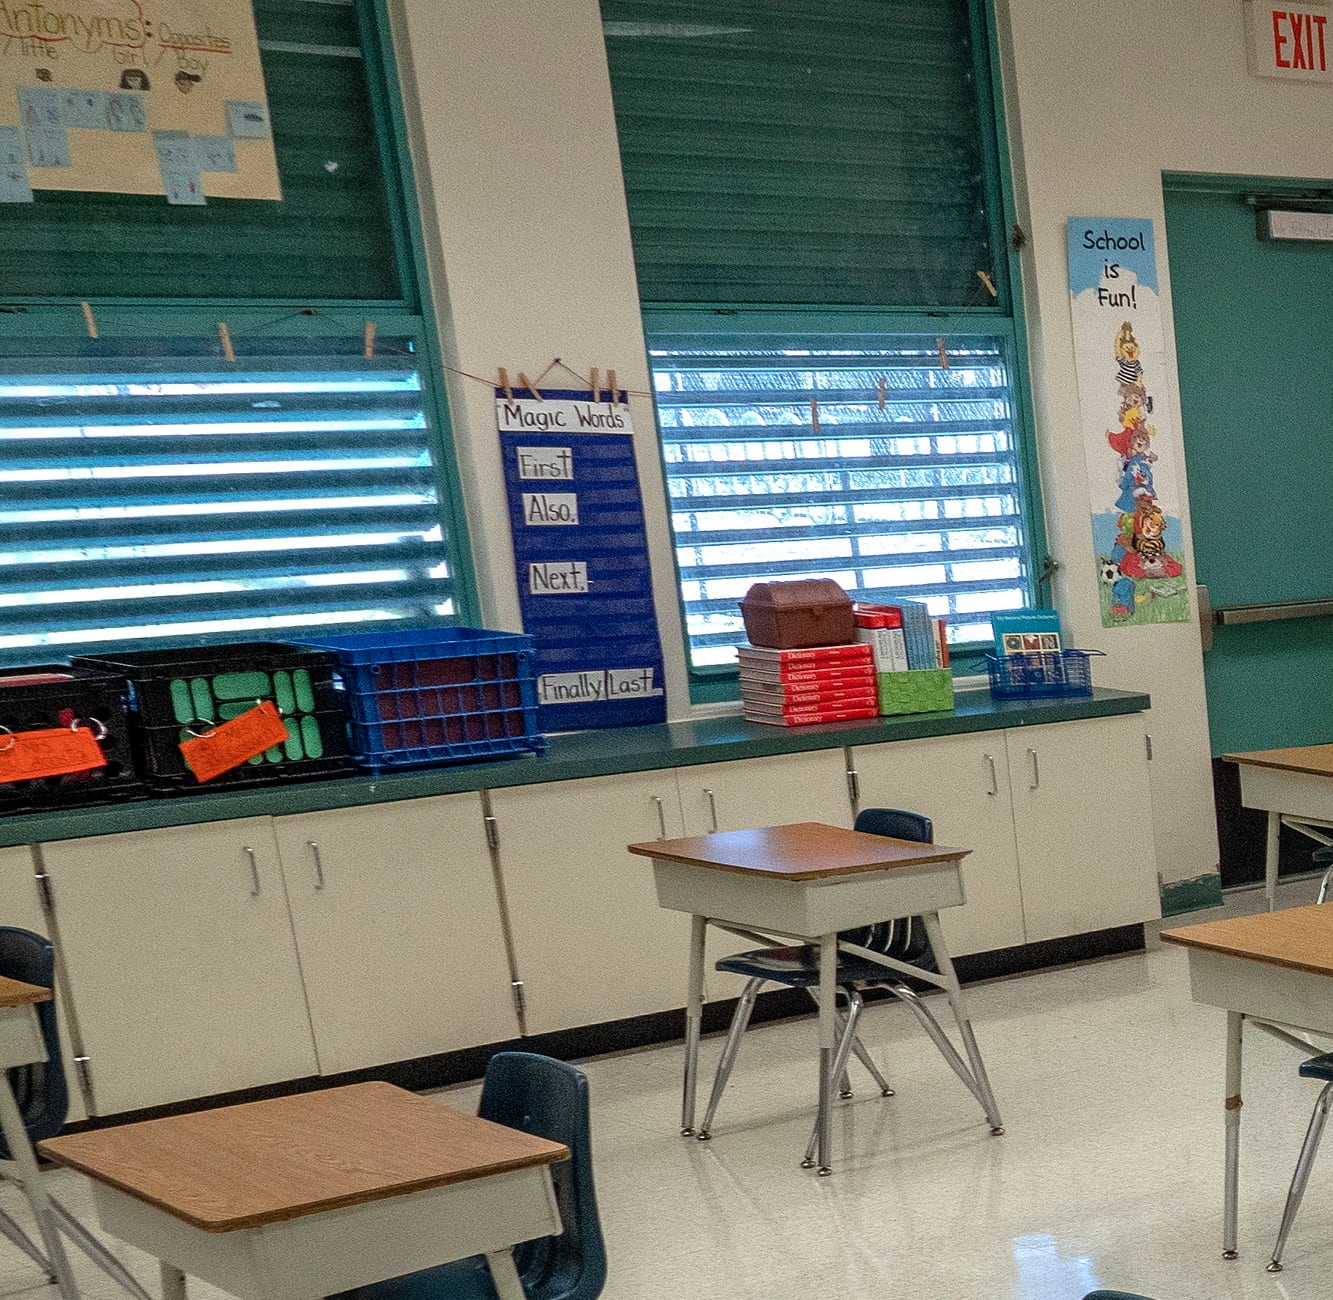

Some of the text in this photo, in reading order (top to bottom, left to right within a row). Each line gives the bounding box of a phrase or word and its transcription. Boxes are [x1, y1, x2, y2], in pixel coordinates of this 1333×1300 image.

[1272, 11, 1327, 70] EXIT
[1083, 230, 1146, 251] School
[1104, 258, 1120, 279] is
[1098, 285, 1137, 309] Fun!
[504, 404, 625, 431] Magic Words
[519, 450, 571, 478] First
[542, 669, 652, 700] Finally Last
